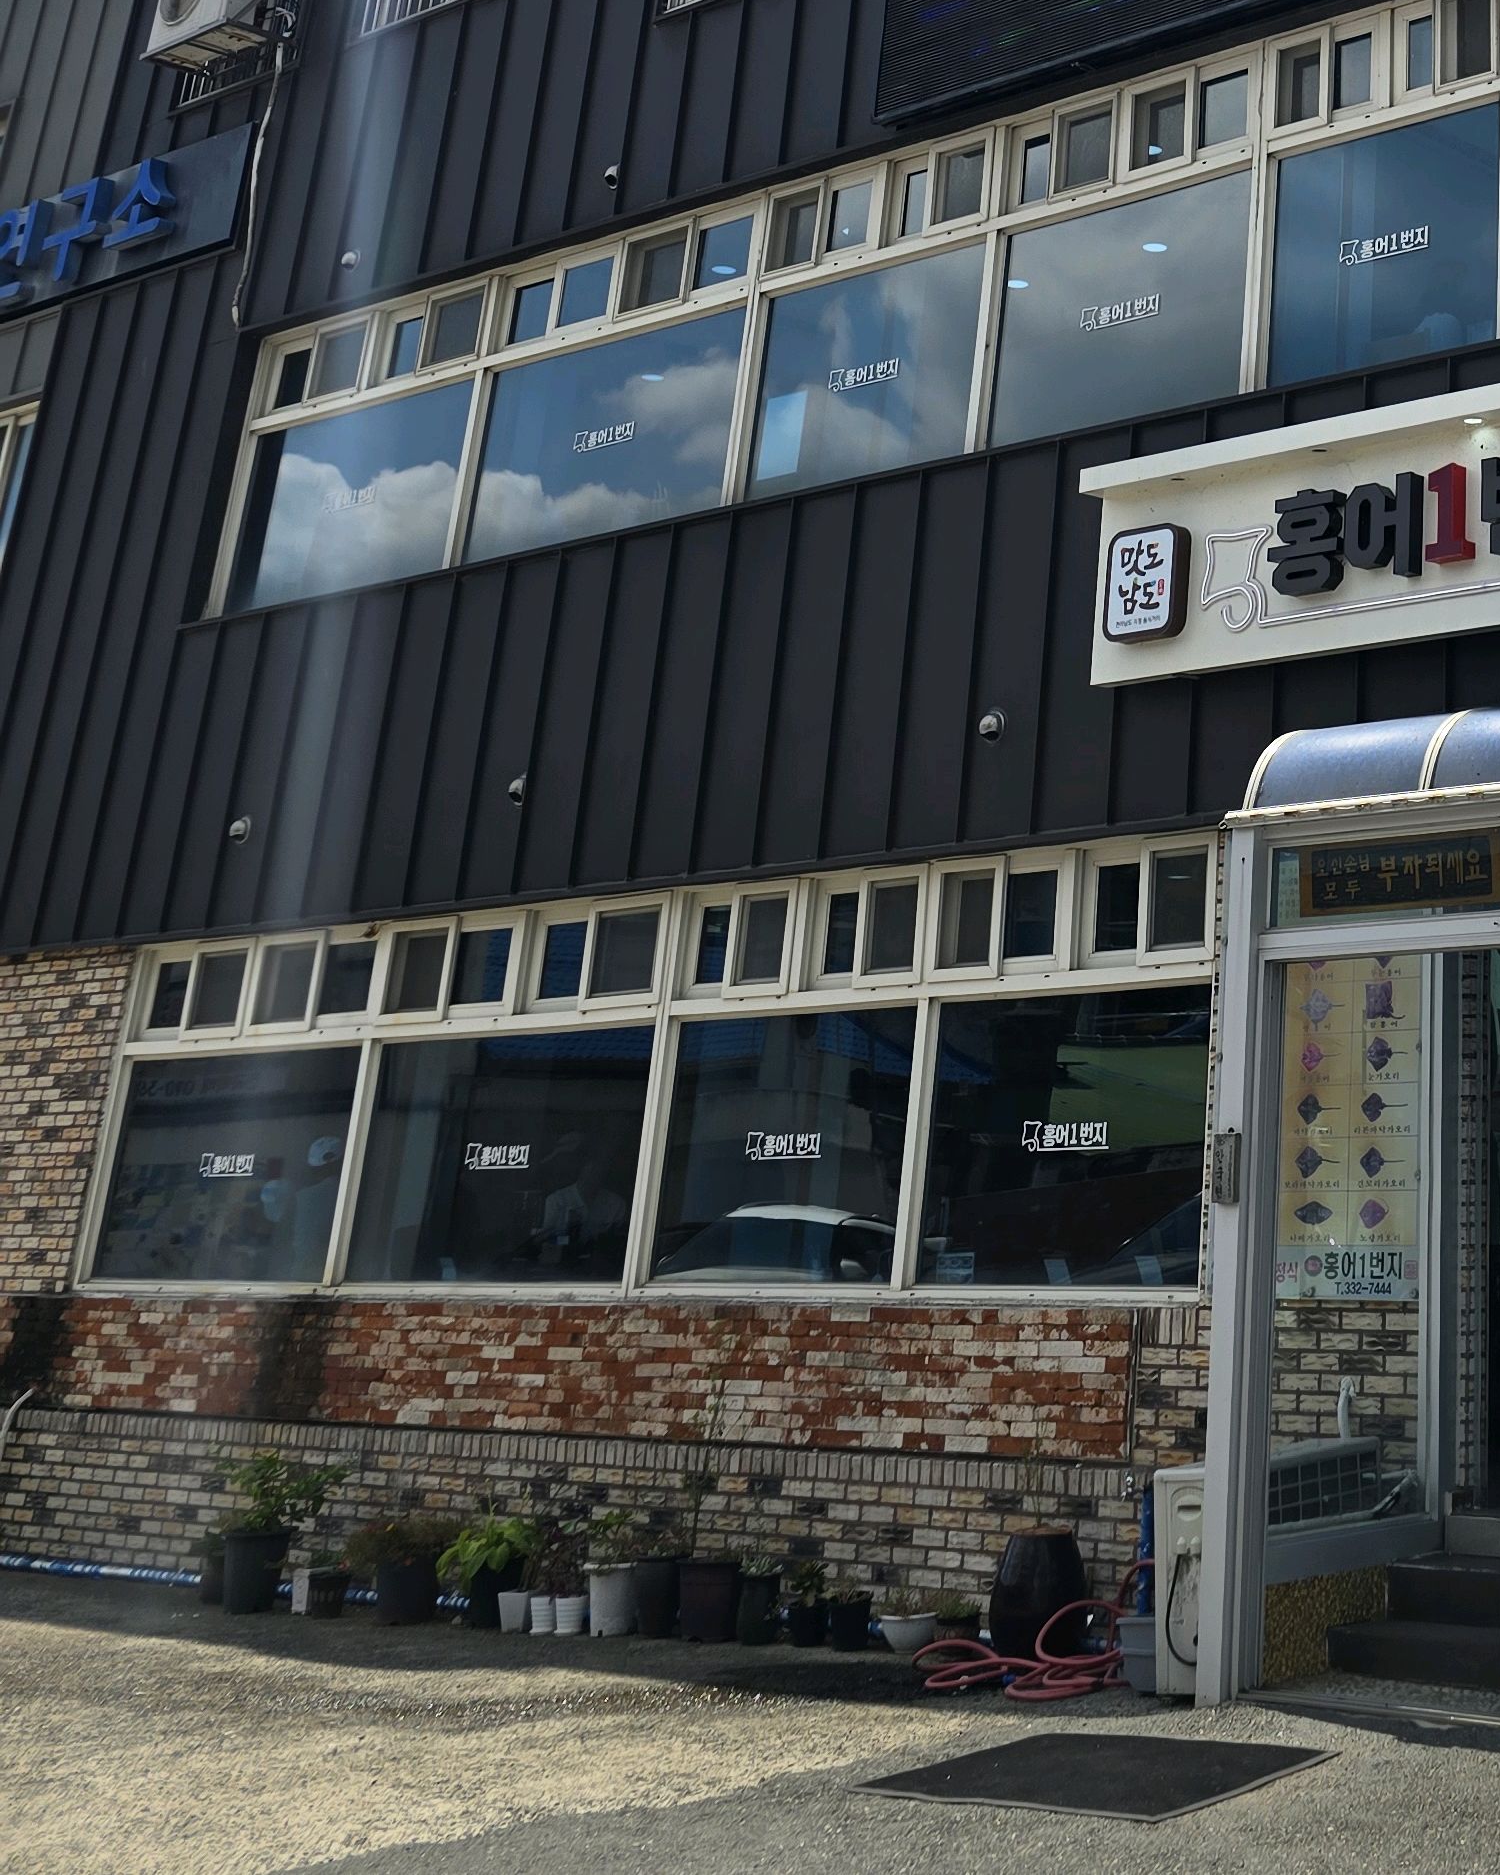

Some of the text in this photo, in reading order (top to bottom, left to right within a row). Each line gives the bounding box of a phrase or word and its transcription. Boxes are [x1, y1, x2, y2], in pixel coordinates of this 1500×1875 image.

[1360, 225, 1429, 258] 홍어1번지
[1098, 293, 1160, 324] 홍어1번지
[844, 358, 899, 386] 홍어1번지
[587, 421, 635, 447] 홍어1번지
[763, 1133, 821, 1155] 홍어1번지
[1042, 1121, 1107, 1146] 홍어1번지
[480, 1145, 530, 1166] 홍어1번지
[1324, 1251, 1403, 1280] 홍어1번지
